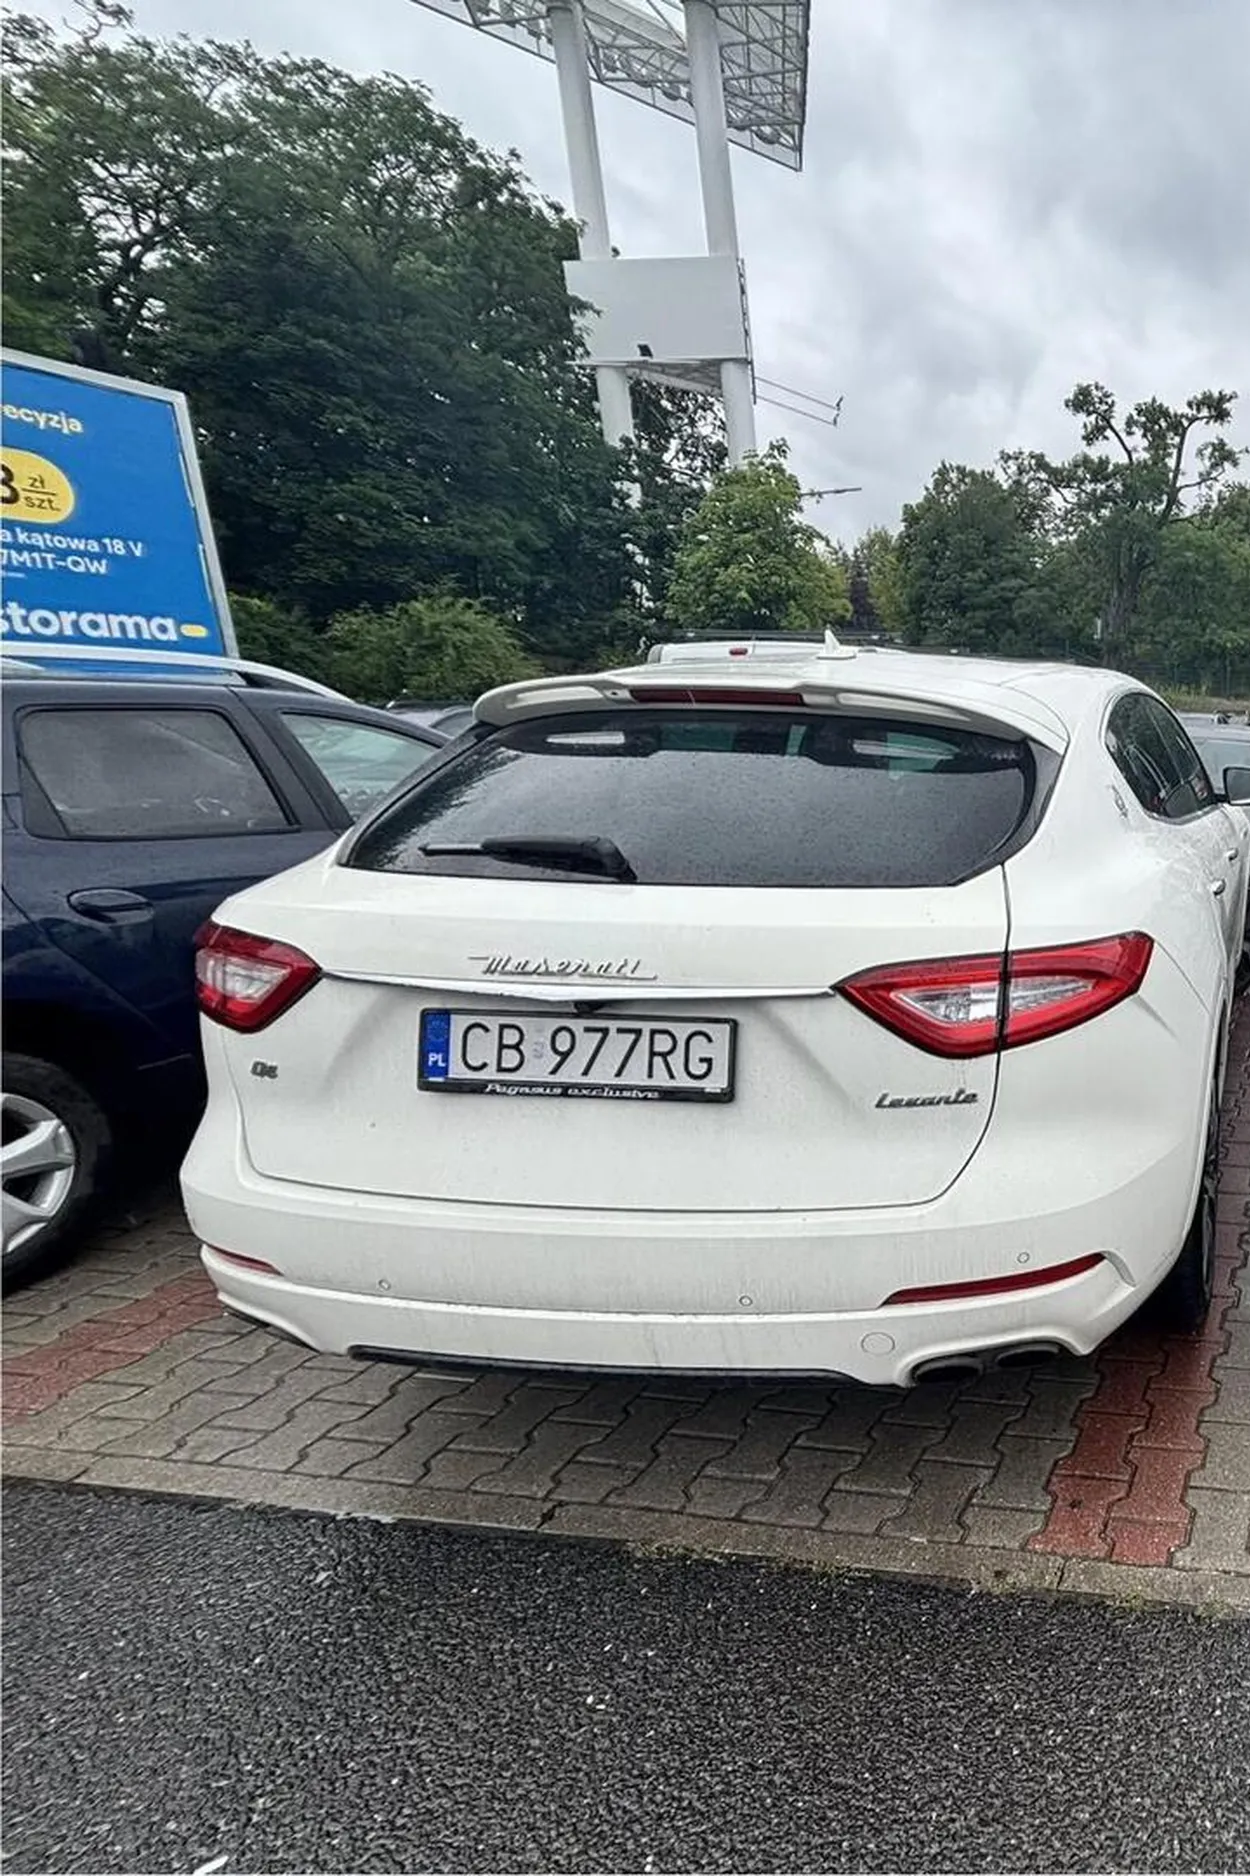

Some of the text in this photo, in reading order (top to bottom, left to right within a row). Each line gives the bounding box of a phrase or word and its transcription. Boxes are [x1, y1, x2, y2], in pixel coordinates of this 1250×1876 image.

[0, 403, 83, 435] ecyzja
[28, 474, 46, 489] zł
[24, 495, 61, 512] szt.
[14, 527, 100, 553] kątowa
[102, 537, 126, 556] 18
[128, 541, 143, 557] V
[468, 956, 658, 981] Maserati
[428, 1055, 446, 1068] PL
[461, 1022, 714, 1081] CB 977RG
[567, 1086, 660, 1099] exclusive
[875, 1087, 978, 1108] Levante
